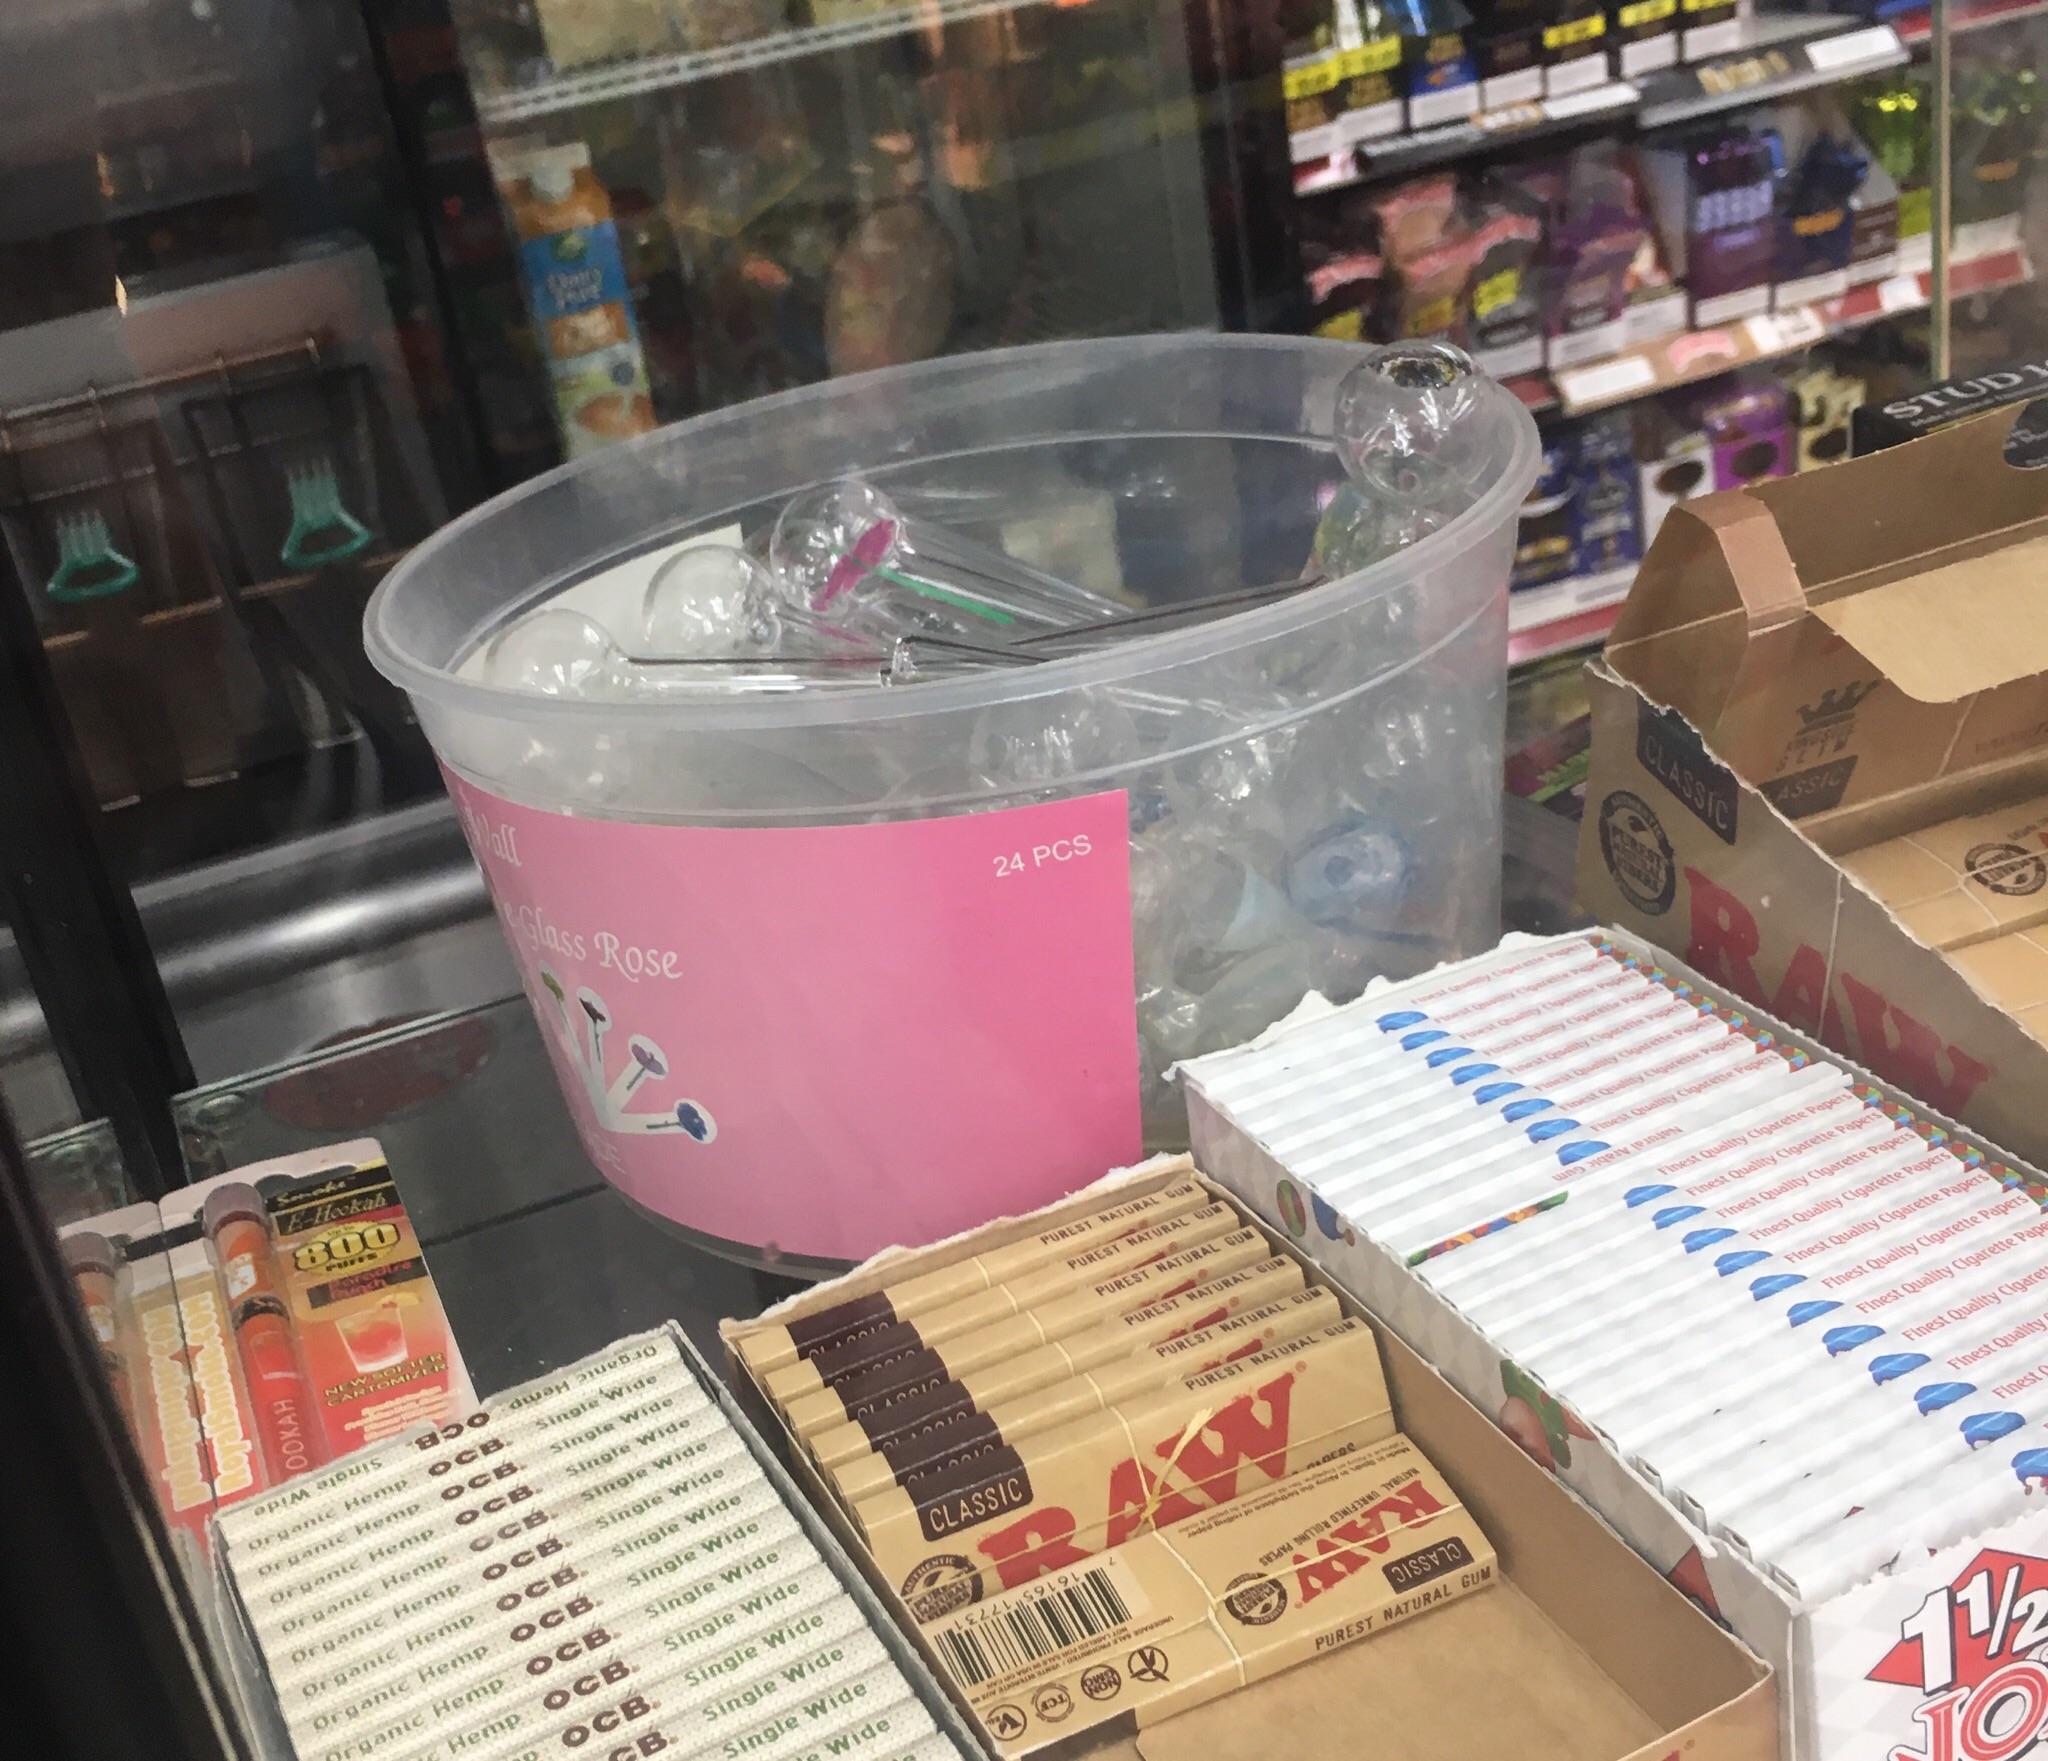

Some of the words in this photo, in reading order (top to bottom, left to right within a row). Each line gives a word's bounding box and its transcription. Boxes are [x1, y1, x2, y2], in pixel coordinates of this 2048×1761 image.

[1883, 372, 2024, 419] STUD
[1647, 736, 1728, 829] CLASSIC
[1777, 767, 1844, 800] ASSIC
[992, 852, 1025, 877] 24
[1033, 834, 1092, 867] PCS
[594, 932, 683, 983] Rose
[1684, 866, 1992, 1117] RAW
[1591, 1112, 1629, 1132] Finest
[1631, 1091, 1677, 1116] Quality
[1677, 1070, 1734, 1098] Cigarette
[1735, 1053, 1778, 1073] Papers
[1658, 1155, 1701, 1175] Finest
[1700, 1134, 1748, 1159] Quality
[1748, 1111, 1808, 1139] Cigarette
[1807, 1093, 1853, 1115] Papers
[1686, 1175, 1729, 1197] Finest
[1728, 1155, 1778, 1180] Quality
[1776, 1131, 1836, 1159] Cigarette
[1836, 1111, 1882, 1134] Papers
[1716, 1196, 1761, 1218] Finest
[1759, 1175, 1809, 1201] Quality
[1808, 1151, 1869, 1179] Cigarette
[1868, 1131, 1916, 1155] Papers
[1749, 1218, 1795, 1240] Finest
[1792, 1197, 1844, 1222] Quality
[1842, 1173, 1906, 1201] Cigarette
[1902, 1152, 1951, 1176] Papers
[293, 1222, 400, 1271] 800
[1040, 1221, 1092, 1245] PUREST
[1098, 1197, 1160, 1223] NATURAL
[1166, 1184, 1194, 1198] GUM
[1067, 1244, 1120, 1270] PUREST
[1126, 1218, 1189, 1246] NATURAL
[1194, 1205, 1223, 1220] GUM
[1784, 1240, 1831, 1264] Finest
[1829, 1219, 1881, 1245] Quality
[1878, 1193, 1942, 1223] Cigarette
[1940, 1173, 1990, 1197] Papers
[1821, 1265, 1870, 1289] Finest
[1866, 1242, 1919, 1269] Quality
[1917, 1215, 1981, 1244] Cigarette
[1978, 1195, 2029, 1220] Papers
[1095, 1270, 1150, 1296] PUREST
[1156, 1244, 1221, 1272] NATURAL
[1224, 1231, 1255, 1245] GUM
[1124, 1299, 1180, 1325] PUREST
[1187, 1273, 1252, 1301] NATURAL
[1256, 1259, 1286, 1274] GUM
[1856, 1289, 1904, 1314] Finest
[1902, 1265, 1955, 1294] Quality
[1952, 1237, 2017, 1269] Cigarette
[2014, 1220, 2048, 1242] Pape
[1156, 1331, 1214, 1357] PUREST
[1219, 1304, 1287, 1333] NATURAL
[1291, 1288, 1323, 1304] GUM
[1902, 1316, 1951, 1341] Finest
[1948, 1292, 2002, 1321] Quality
[1998, 1266, 2048, 1296] Cigaret
[577, 1346, 657, 1383] Organic
[1185, 1364, 1244, 1391] PUREST
[1250, 1334, 1319, 1365] NATURAL
[1324, 1321, 1356, 1337] GUM
[1948, 1344, 1993, 1370] Finest
[1993, 1319, 2048, 1348] Quality
[324, 1376, 367, 1397] NEW
[509, 1380, 570, 1410] Hemp
[1992, 1369, 2042, 1399] Finest
[274, 1399, 308, 1470] OOKAH
[415, 1413, 490, 1450] OCB
[428, 1439, 504, 1476] OCB
[600, 1374, 657, 1401] Wide
[441, 1462, 518, 1500] OCB
[620, 1398, 673, 1424] Wide
[456, 1485, 533, 1525] OCB
[566, 1444, 631, 1477] Single
[636, 1418, 690, 1446] Wide
[469, 1510, 548, 1552] OCB
[581, 1468, 648, 1502] Single
[653, 1442, 708, 1470] Wide
[929, 1478, 1023, 1533] CLASSIC
[977, 1368, 1299, 1590] RAW
[1330, 1490, 1381, 1522] UNREFINED
[1381, 1468, 1420, 1491] NATURAL
[393, 1582, 462, 1618] Hemp
[482, 1538, 563, 1580] OCB
[596, 1495, 663, 1530] Single
[668, 1468, 724, 1497] Wide
[1259, 1542, 1294, 1567] PAPERS
[1293, 1519, 1331, 1546] ROLLING
[1293, 1480, 1448, 1604] RAW
[1392, 1542, 1462, 1583] CLASSIC
[302, 1648, 398, 1697] Organic
[406, 1615, 475, 1651] Hemp
[496, 1566, 579, 1611] OCB
[612, 1522, 679, 1558] Single
[685, 1495, 741, 1524] Wide
[954, 1599, 1011, 1630] 17731
[1024, 1572, 1081, 1601] 16165
[1315, 1616, 1374, 1650] PUREST
[1383, 1584, 1453, 1621] NATURAL
[1461, 1566, 1491, 1588] GUM
[313, 1679, 410, 1731] Organic
[418, 1645, 488, 1683] Hemp
[510, 1597, 594, 1642] OCB
[627, 1550, 696, 1588] Single
[701, 1522, 759, 1553] Wide
[326, 1714, 425, 1761] Organic
[432, 1677, 504, 1719] Hemp
[526, 1628, 612, 1675] OCB
[645, 1581, 716, 1619] Single
[720, 1551, 779, 1584] Wide
[448, 1714, 521, 1754] Hemp
[543, 1661, 630, 1710] OCB
[663, 1613, 735, 1652] Single
[741, 1582, 800, 1615] Wide
[562, 1696, 650, 1747] OCB
[685, 1646, 758, 1687] Single
[762, 1614, 824, 1649] Wide
[702, 1680, 777, 1722] Single
[781, 1648, 844, 1683] Wide
[1088, 1677, 1118, 1695] NON
[723, 1715, 800, 1760] Single
[803, 1682, 867, 1720] Wide
[825, 1717, 890, 1756] Wide
[1887, 1660, 2048, 1761] JO
